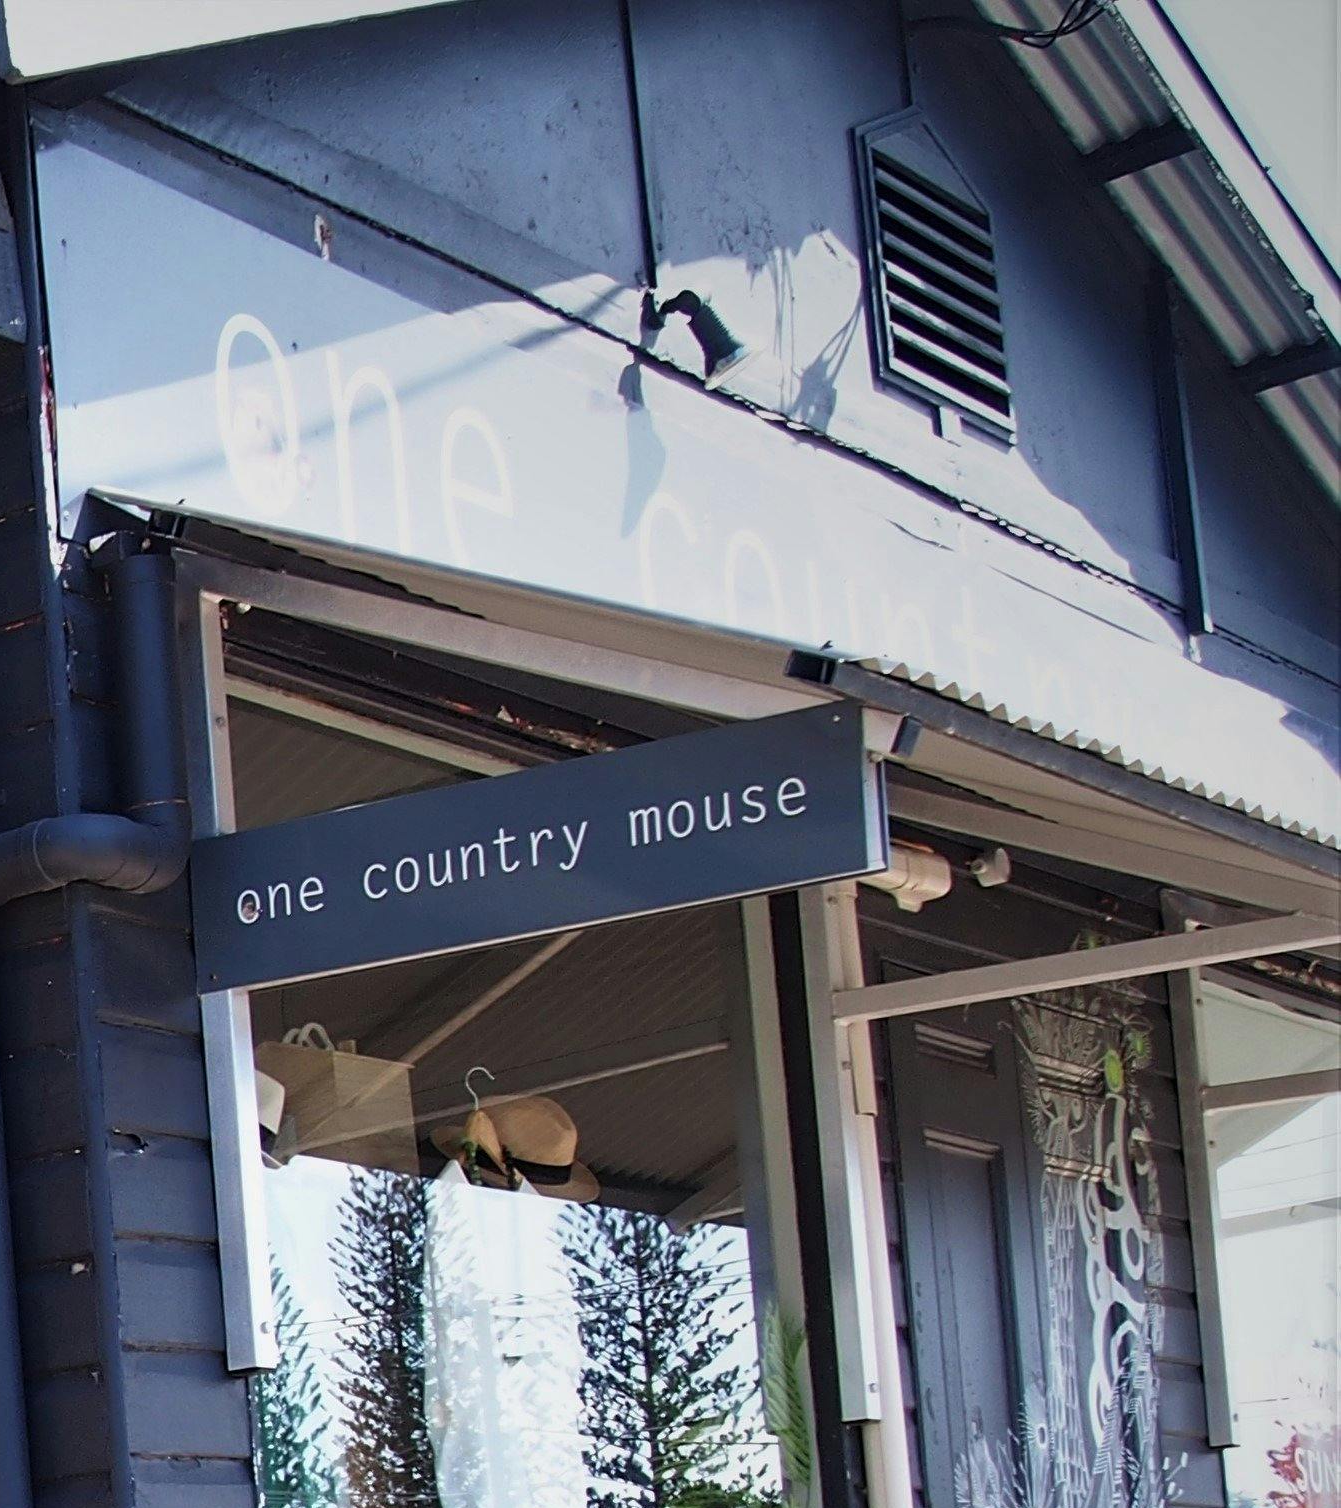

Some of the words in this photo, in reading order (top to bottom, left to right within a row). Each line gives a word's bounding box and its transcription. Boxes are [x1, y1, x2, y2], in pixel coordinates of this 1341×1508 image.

[236, 871, 325, 924] one
[362, 819, 589, 900] country
[628, 776, 808, 847] mouse
